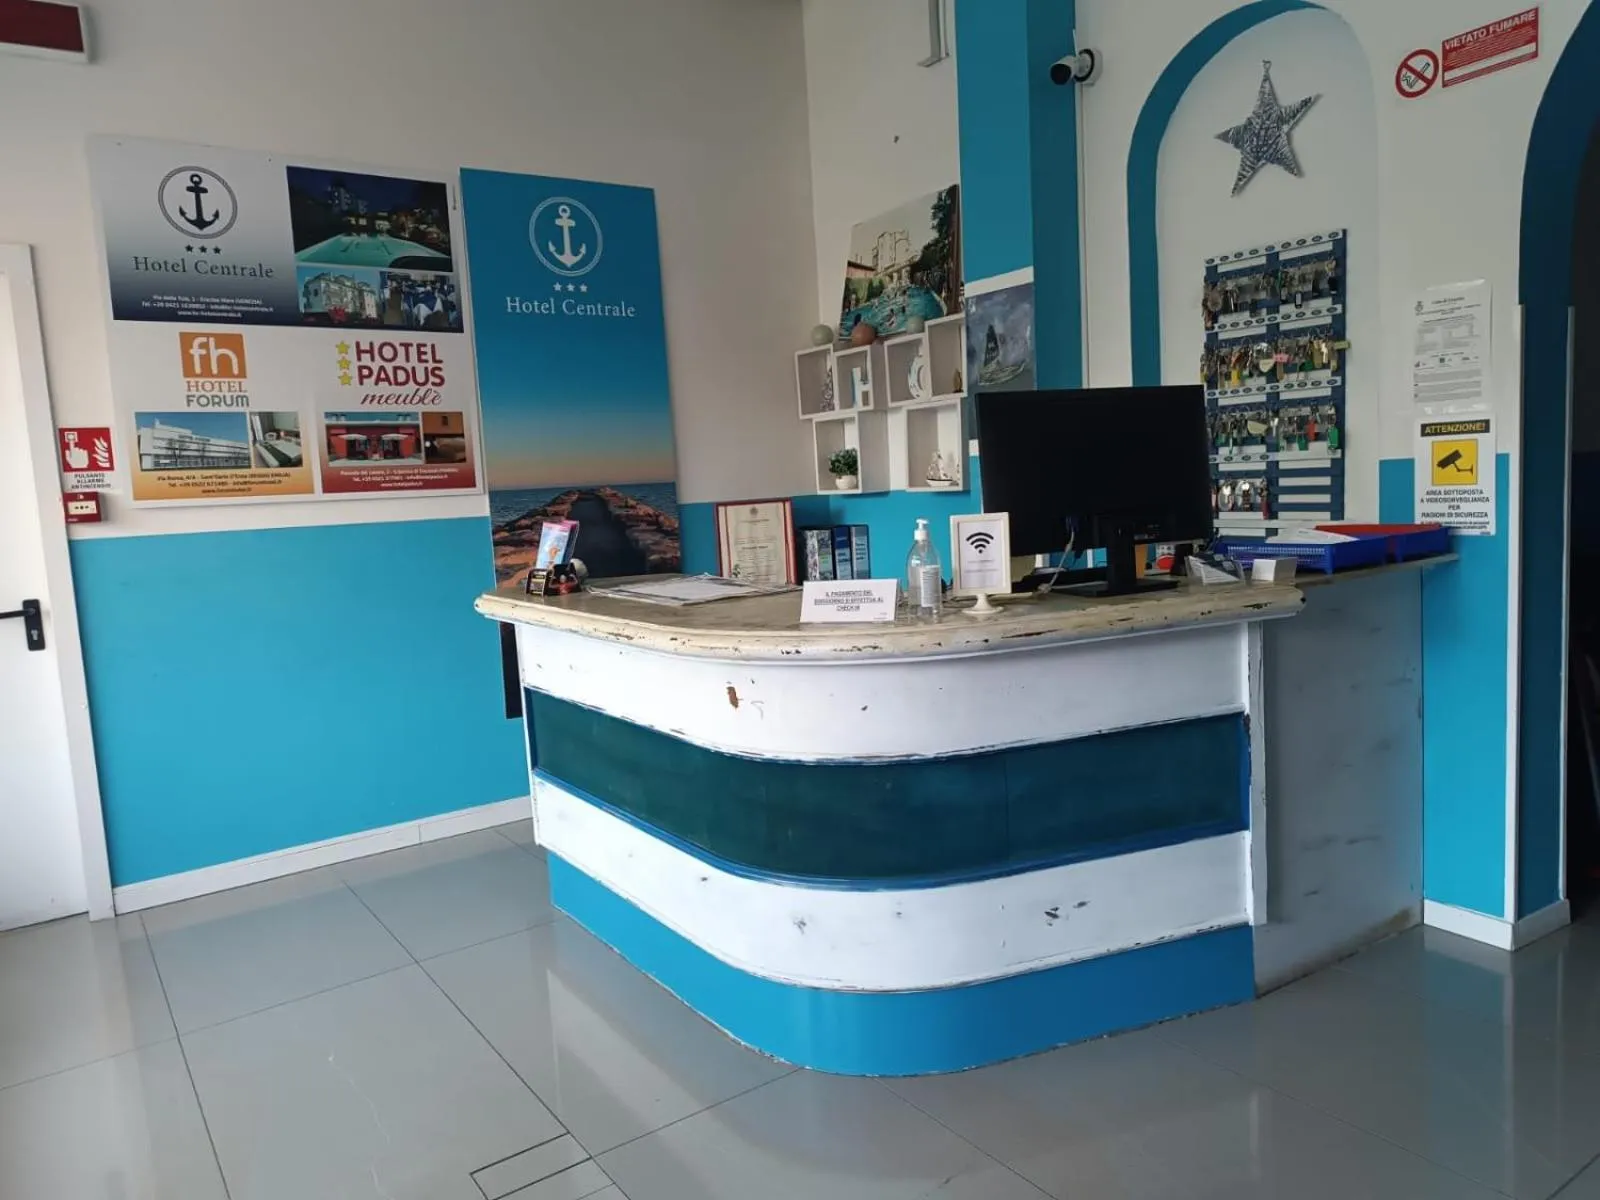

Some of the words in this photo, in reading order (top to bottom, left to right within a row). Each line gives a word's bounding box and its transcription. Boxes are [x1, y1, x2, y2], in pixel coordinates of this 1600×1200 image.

[1444, 28, 1487, 50] VIETATO
[1489, 11, 1536, 34] FUMARE
[133, 256, 187, 273] Hotel
[194, 259, 275, 278] Centrale
[505, 296, 556, 314] Hotel
[562, 299, 636, 317] Centrale
[189, 336, 239, 376] fh
[355, 341, 444, 364] HOTEL
[186, 380, 248, 393] HOTEL
[357, 365, 446, 387] PADUS
[186, 394, 250, 408] FORUM
[1424, 422, 1486, 434] ATTENZIONE!
